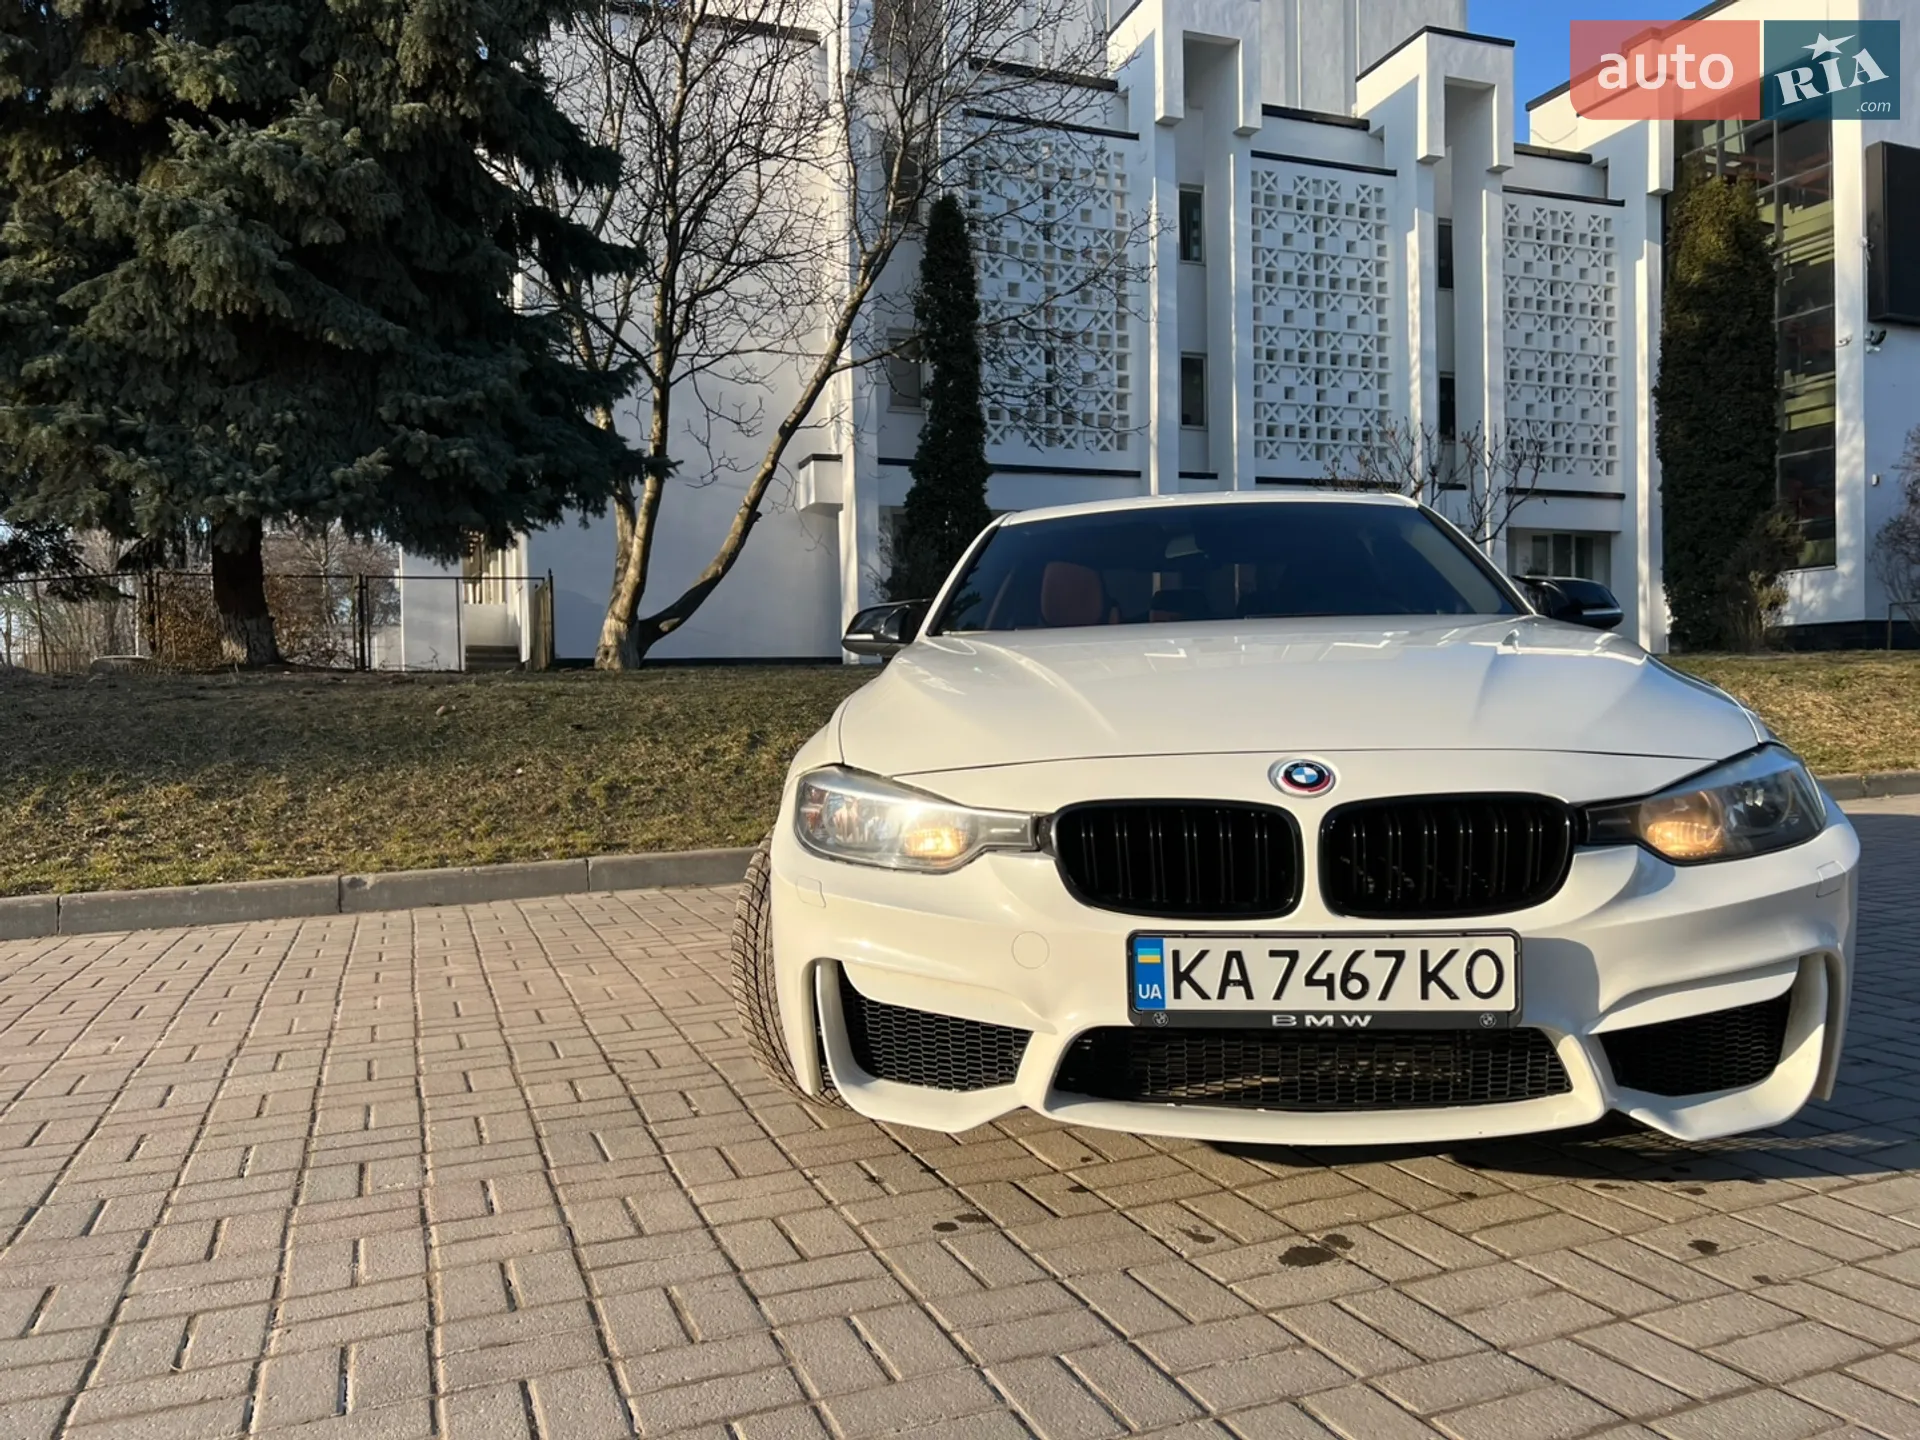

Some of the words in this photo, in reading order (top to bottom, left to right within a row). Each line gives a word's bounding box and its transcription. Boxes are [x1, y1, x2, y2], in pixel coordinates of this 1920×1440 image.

[1171, 949, 1254, 1000] KA
[1268, 949, 1406, 1001] 7467
[1419, 948, 1505, 1000] KO
[1138, 984, 1163, 1000] UA
[1271, 1014, 1374, 1028] BMW
